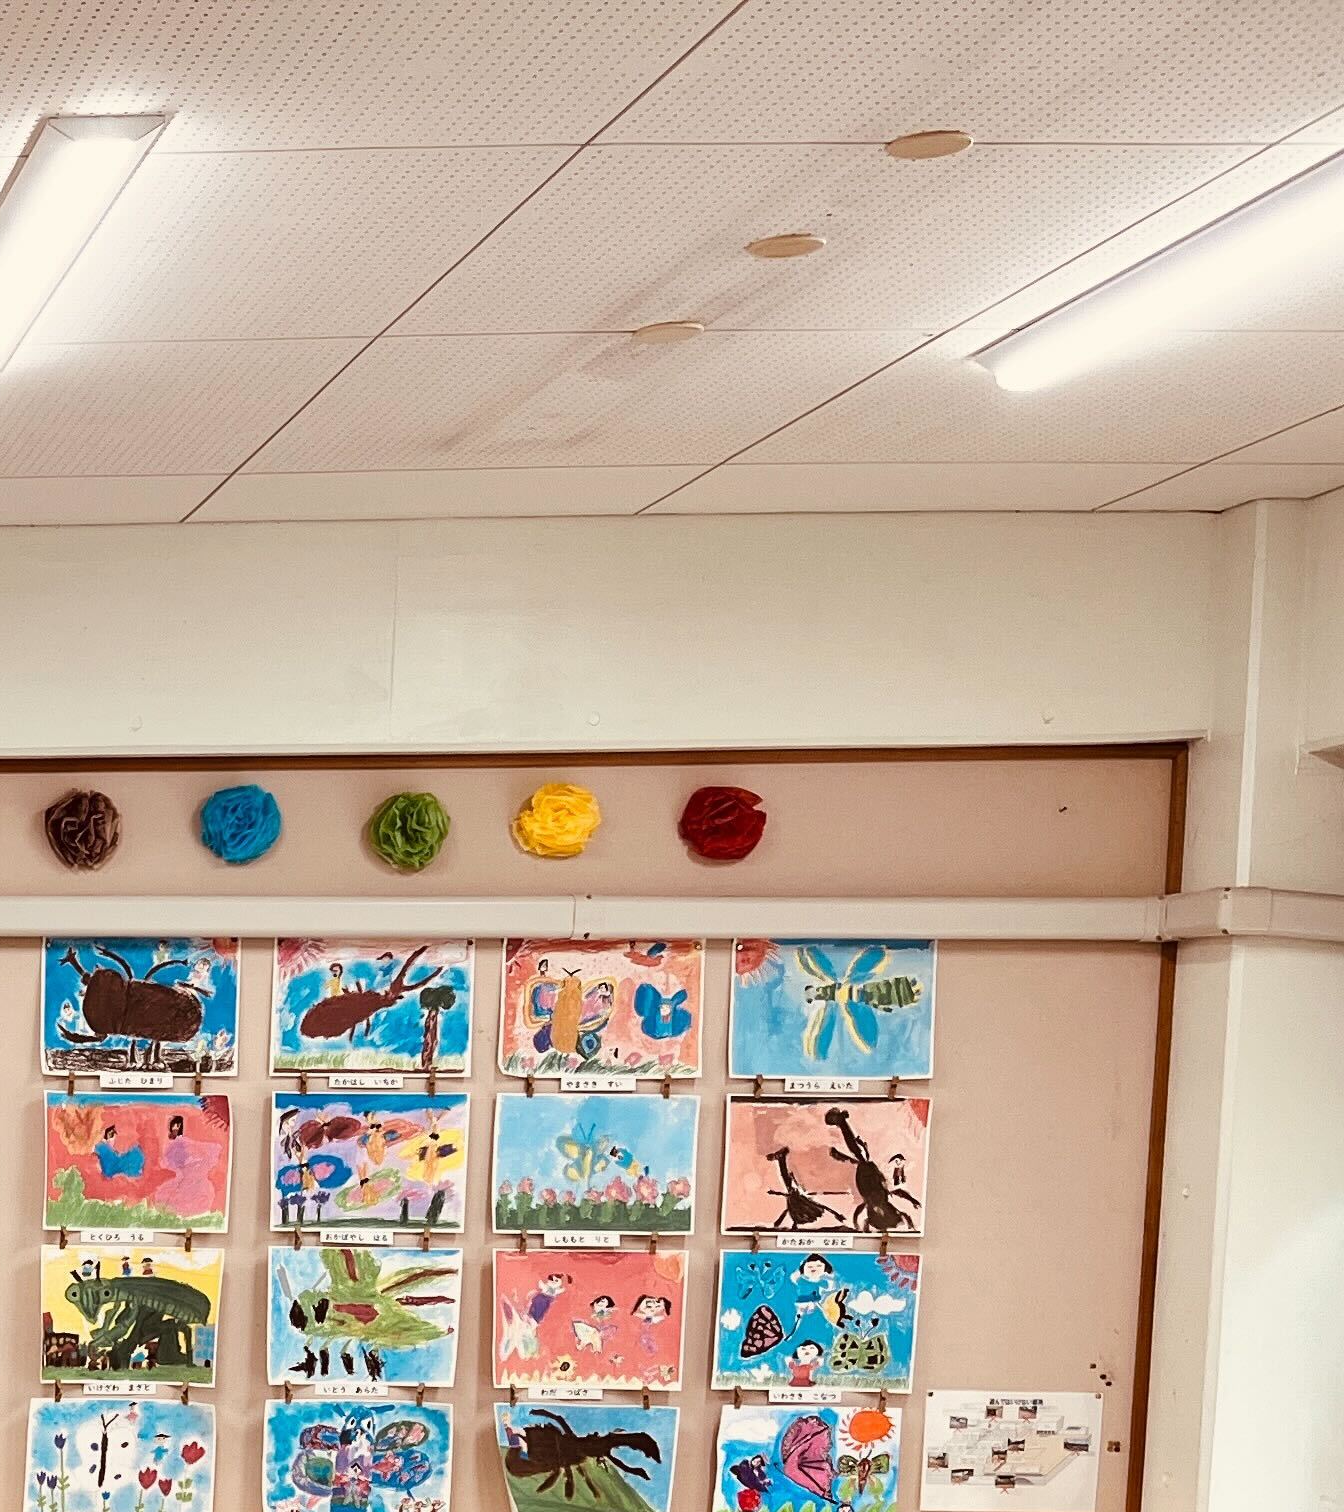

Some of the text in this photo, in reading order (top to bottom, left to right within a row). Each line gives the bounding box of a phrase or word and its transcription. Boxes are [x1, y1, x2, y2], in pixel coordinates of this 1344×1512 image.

[789, 1081, 821, 1090] まつうら
[89, 1233, 121, 1241] とくひろ
[554, 1236, 585, 1244] しももと
[781, 1238, 815, 1246] かたおか
[773, 1392, 803, 1400] いわさき
